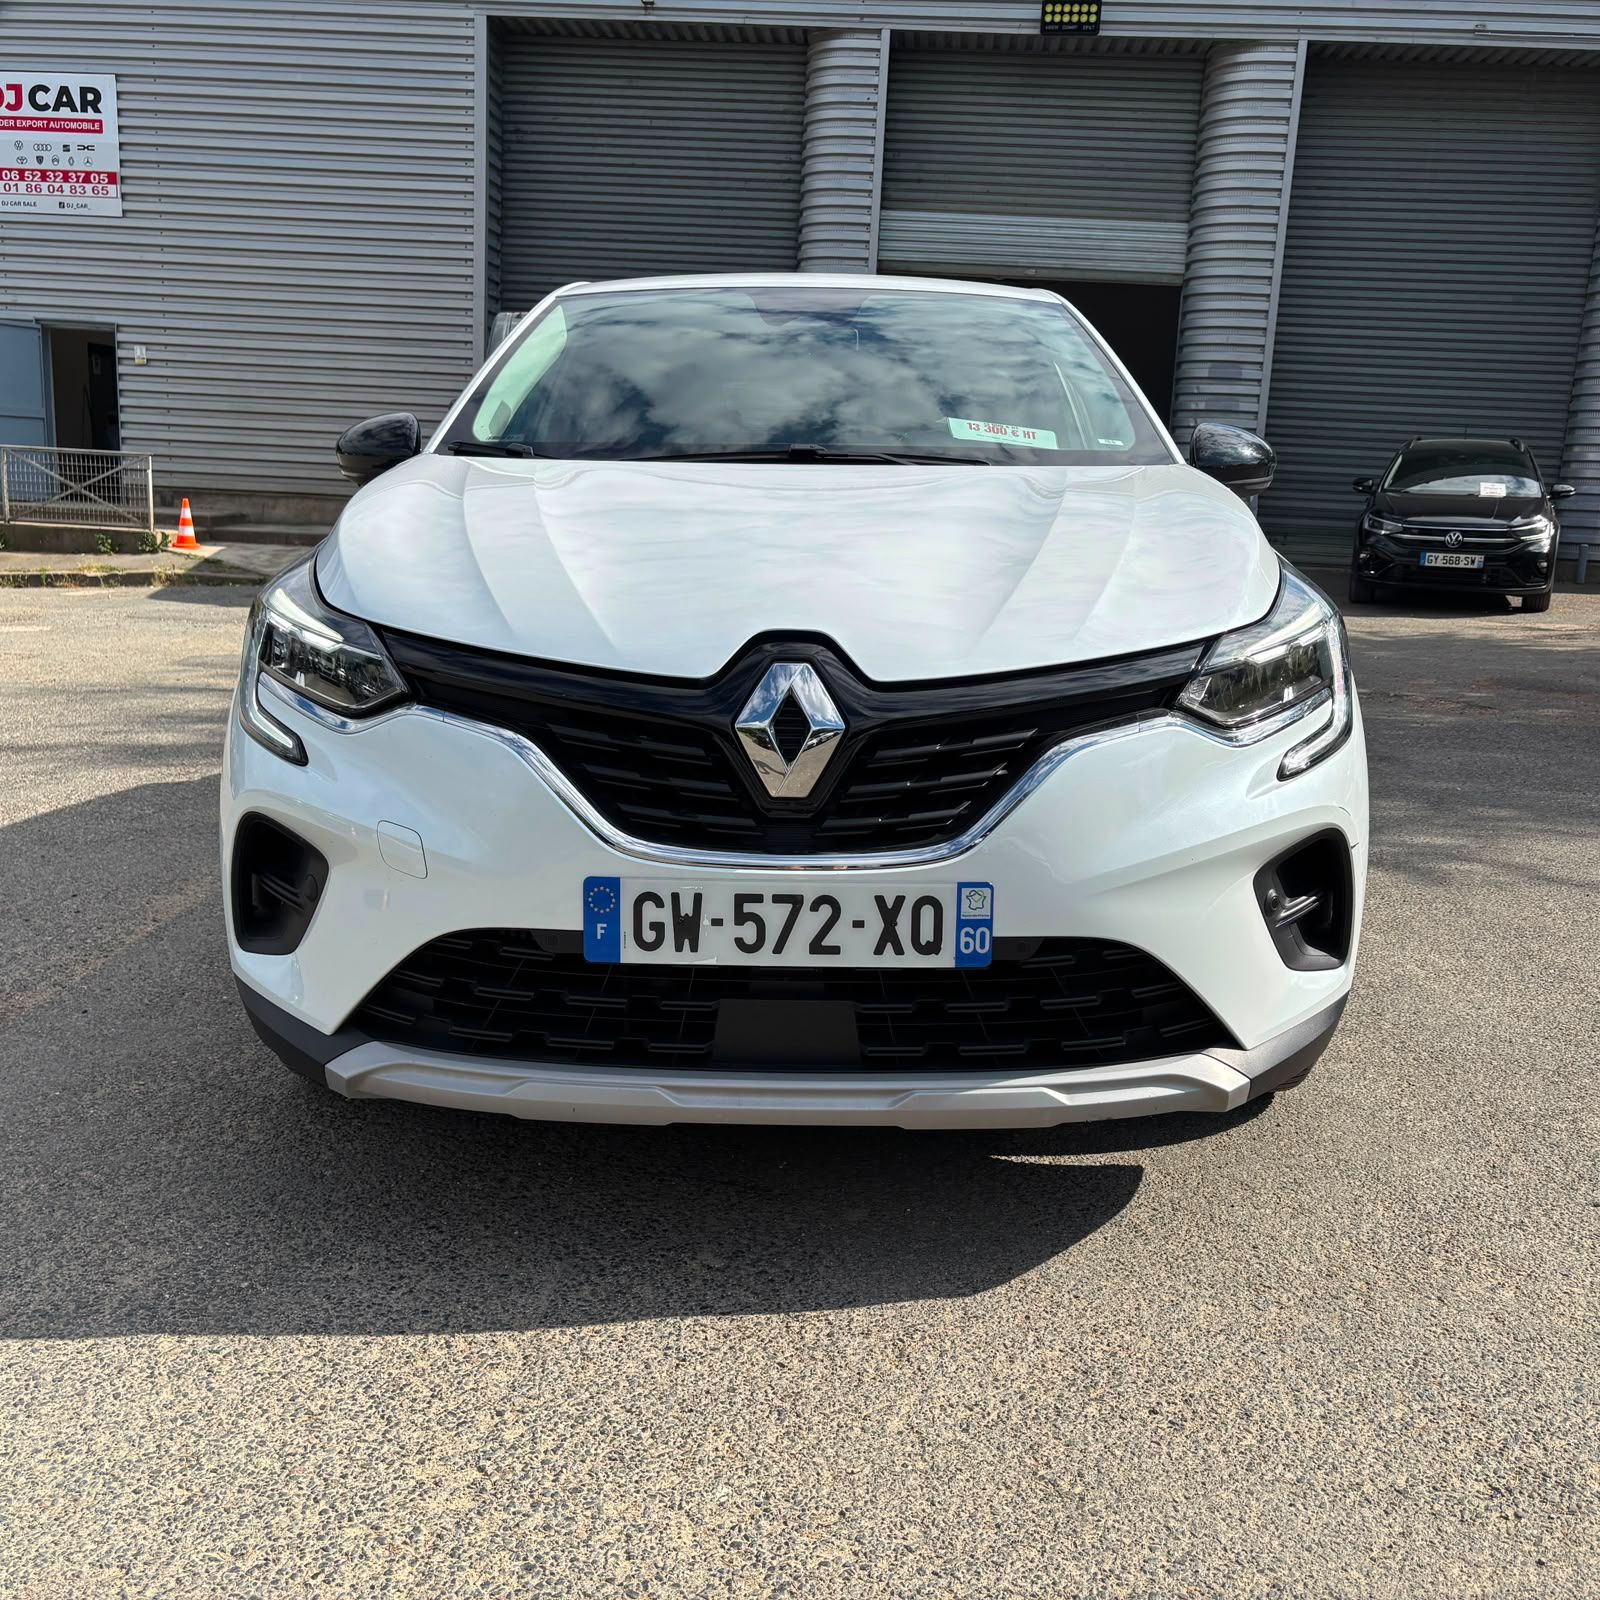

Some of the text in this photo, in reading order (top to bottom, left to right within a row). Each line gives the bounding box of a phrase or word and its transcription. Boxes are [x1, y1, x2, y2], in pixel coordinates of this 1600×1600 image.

[28, 84, 103, 114] CAR
[17, 120, 48, 129] EXPORT
[49, 121, 101, 131] AUTOMOBILE
[2, 171, 109, 184] 06 52 32 37 05
[3, 183, 110, 196] 01 86 04 83 65
[967, 422, 981, 432] 13
[984, 425, 1008, 436] 300
[1023, 430, 1037, 440] HT
[1427, 554, 1477, 566] GY-568-SW
[596, 923, 607, 940] F
[632, 890, 944, 957] GW-572-XQ
[960, 926, 990, 954] 60
